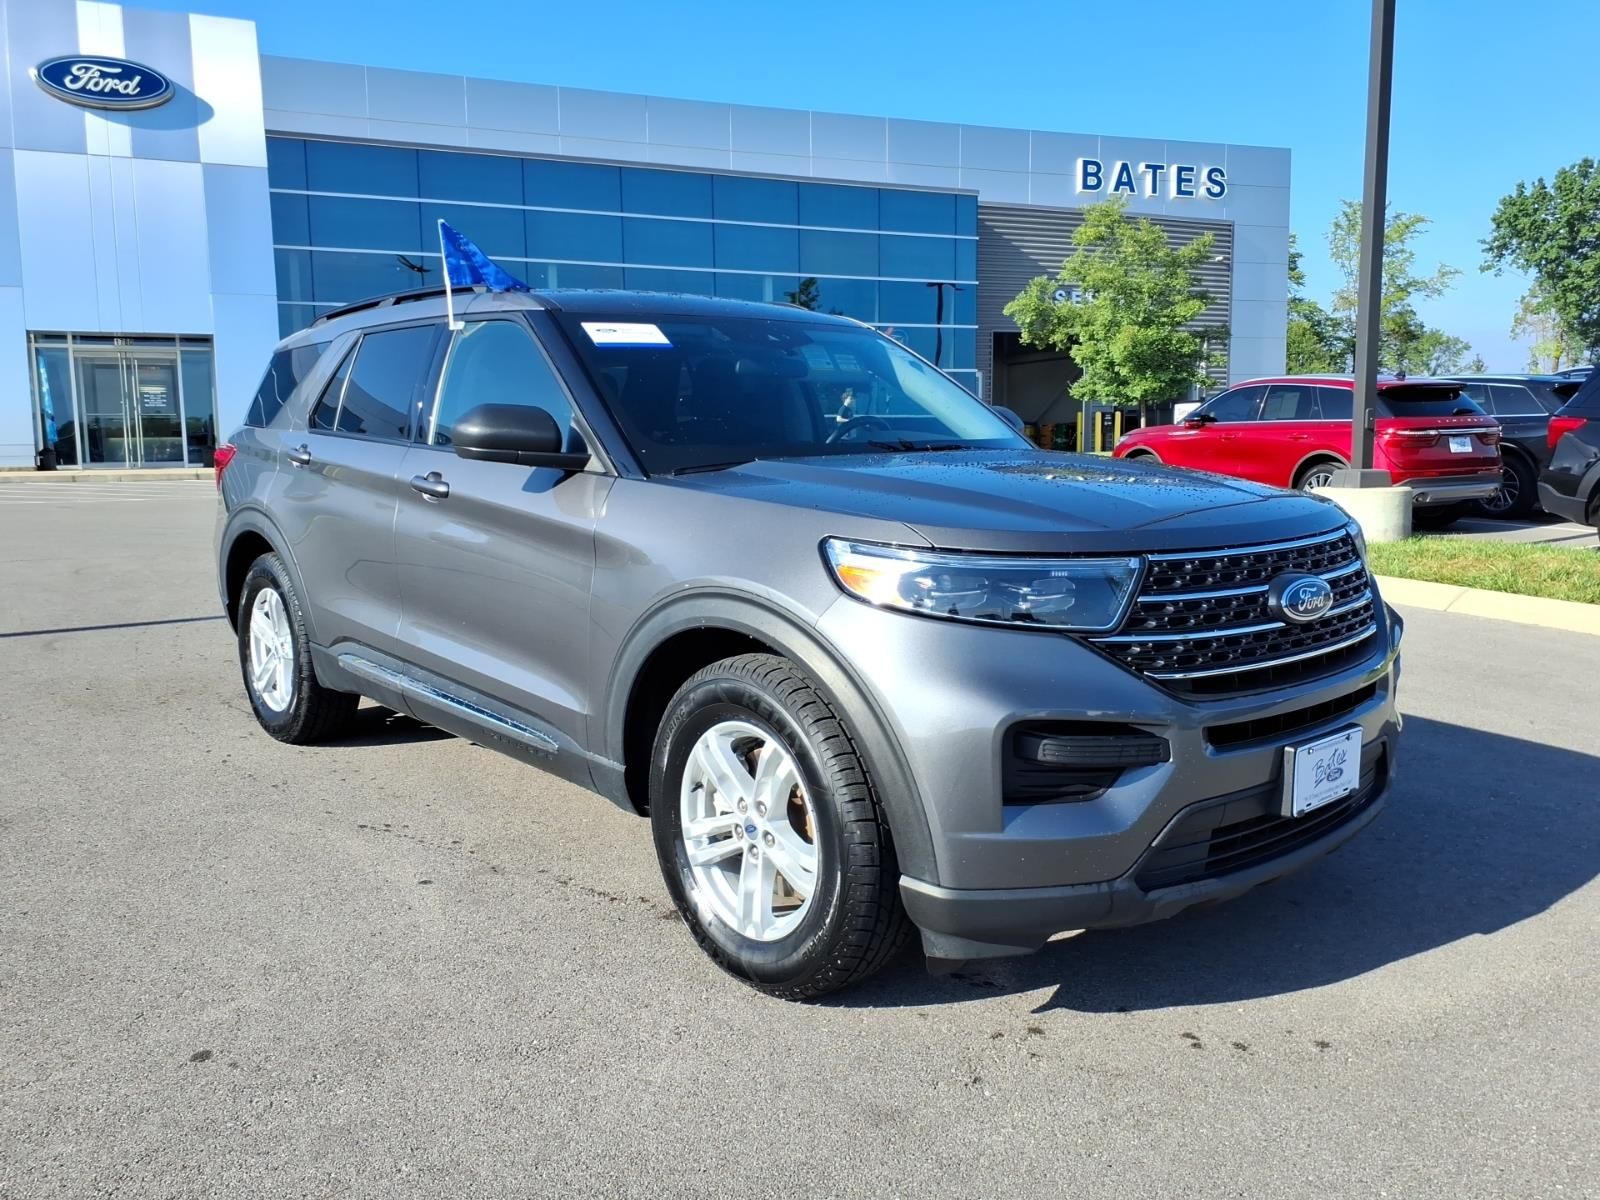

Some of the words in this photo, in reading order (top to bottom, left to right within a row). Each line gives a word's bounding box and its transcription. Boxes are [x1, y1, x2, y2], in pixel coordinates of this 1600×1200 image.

[64, 63, 142, 96] Ford
[1077, 158, 1227, 199] BATES
[1298, 586, 1325, 612] Ford
